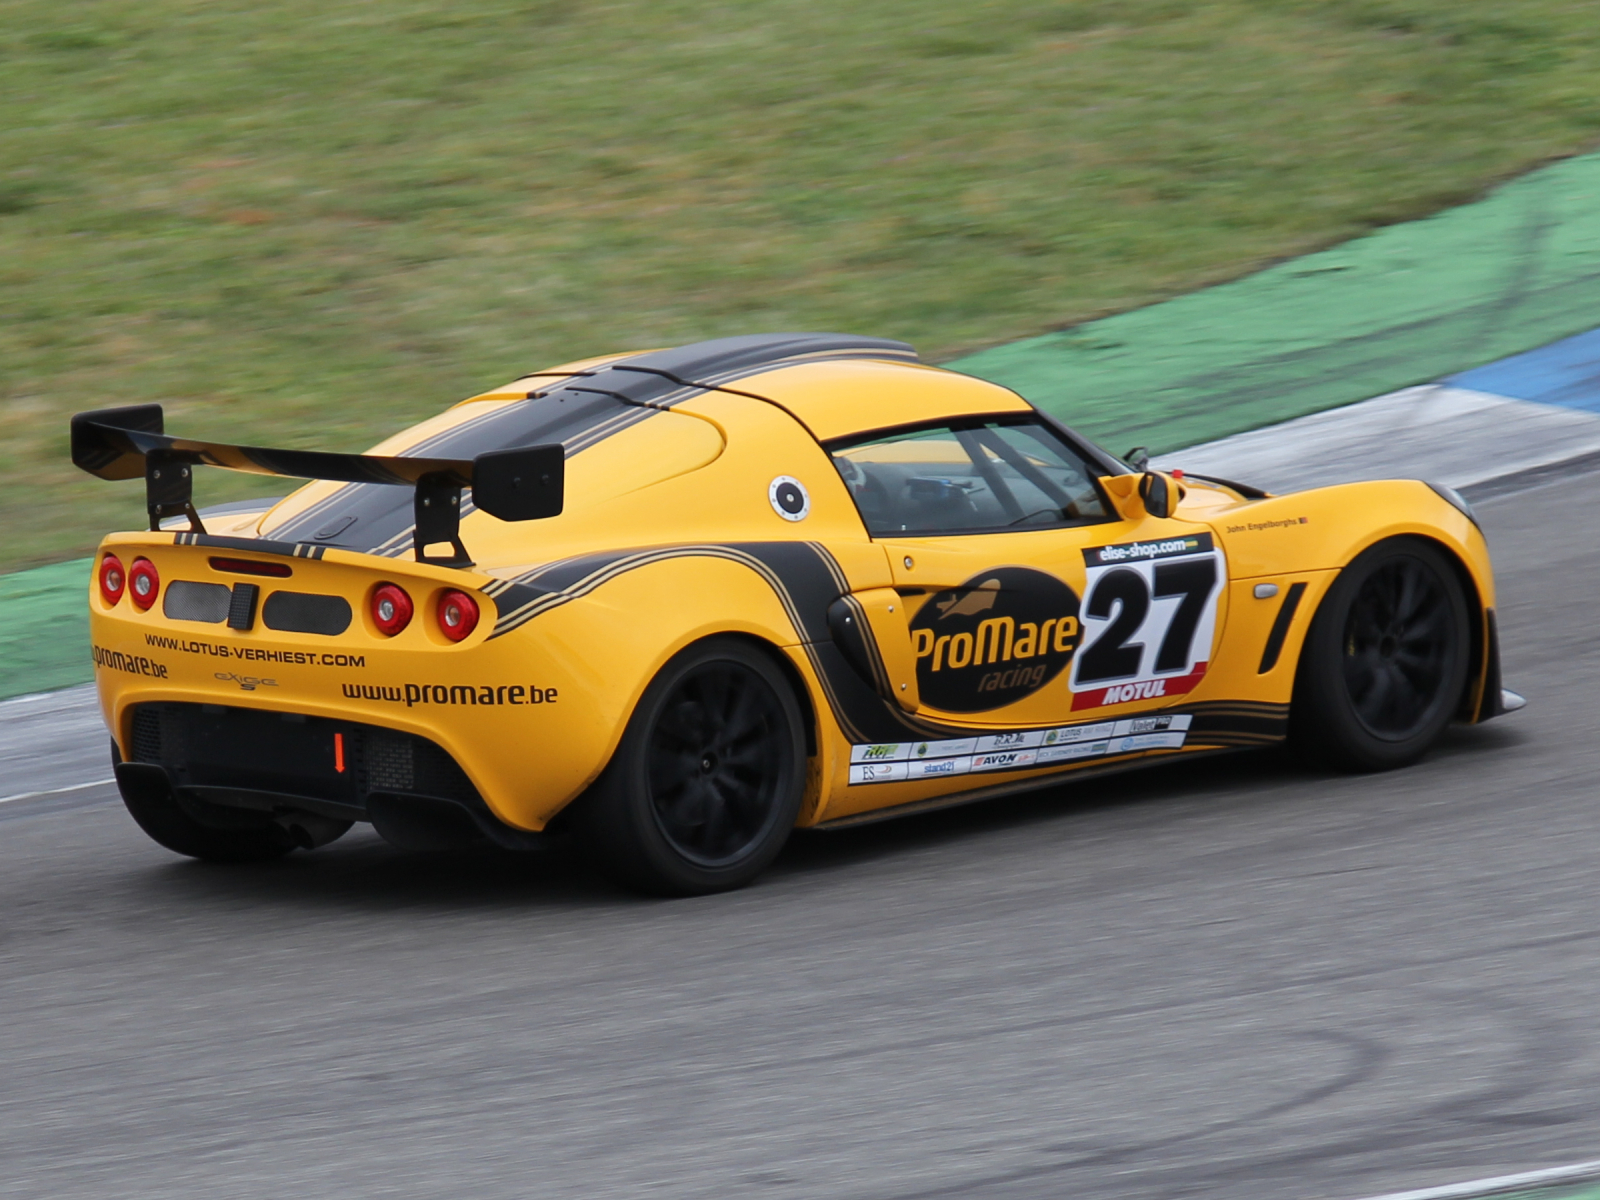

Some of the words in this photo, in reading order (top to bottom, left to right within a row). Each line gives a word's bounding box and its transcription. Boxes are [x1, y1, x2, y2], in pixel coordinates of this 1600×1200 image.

[1226, 524, 1247, 534] John
[1099, 539, 1187, 561] elise-shop.com
[1075, 556, 1217, 686] 27
[144, 633, 366, 668] WWW.LOTUS-VERHIEST.COM
[911, 614, 1078, 673] ProMare
[977, 663, 1047, 694] racing
[341, 681, 558, 707] www.promare.be
[1102, 679, 1167, 705] MOTUL
[862, 765, 875, 781] ES
[924, 761, 955, 774] stand21
[983, 754, 1018, 766] AVON
